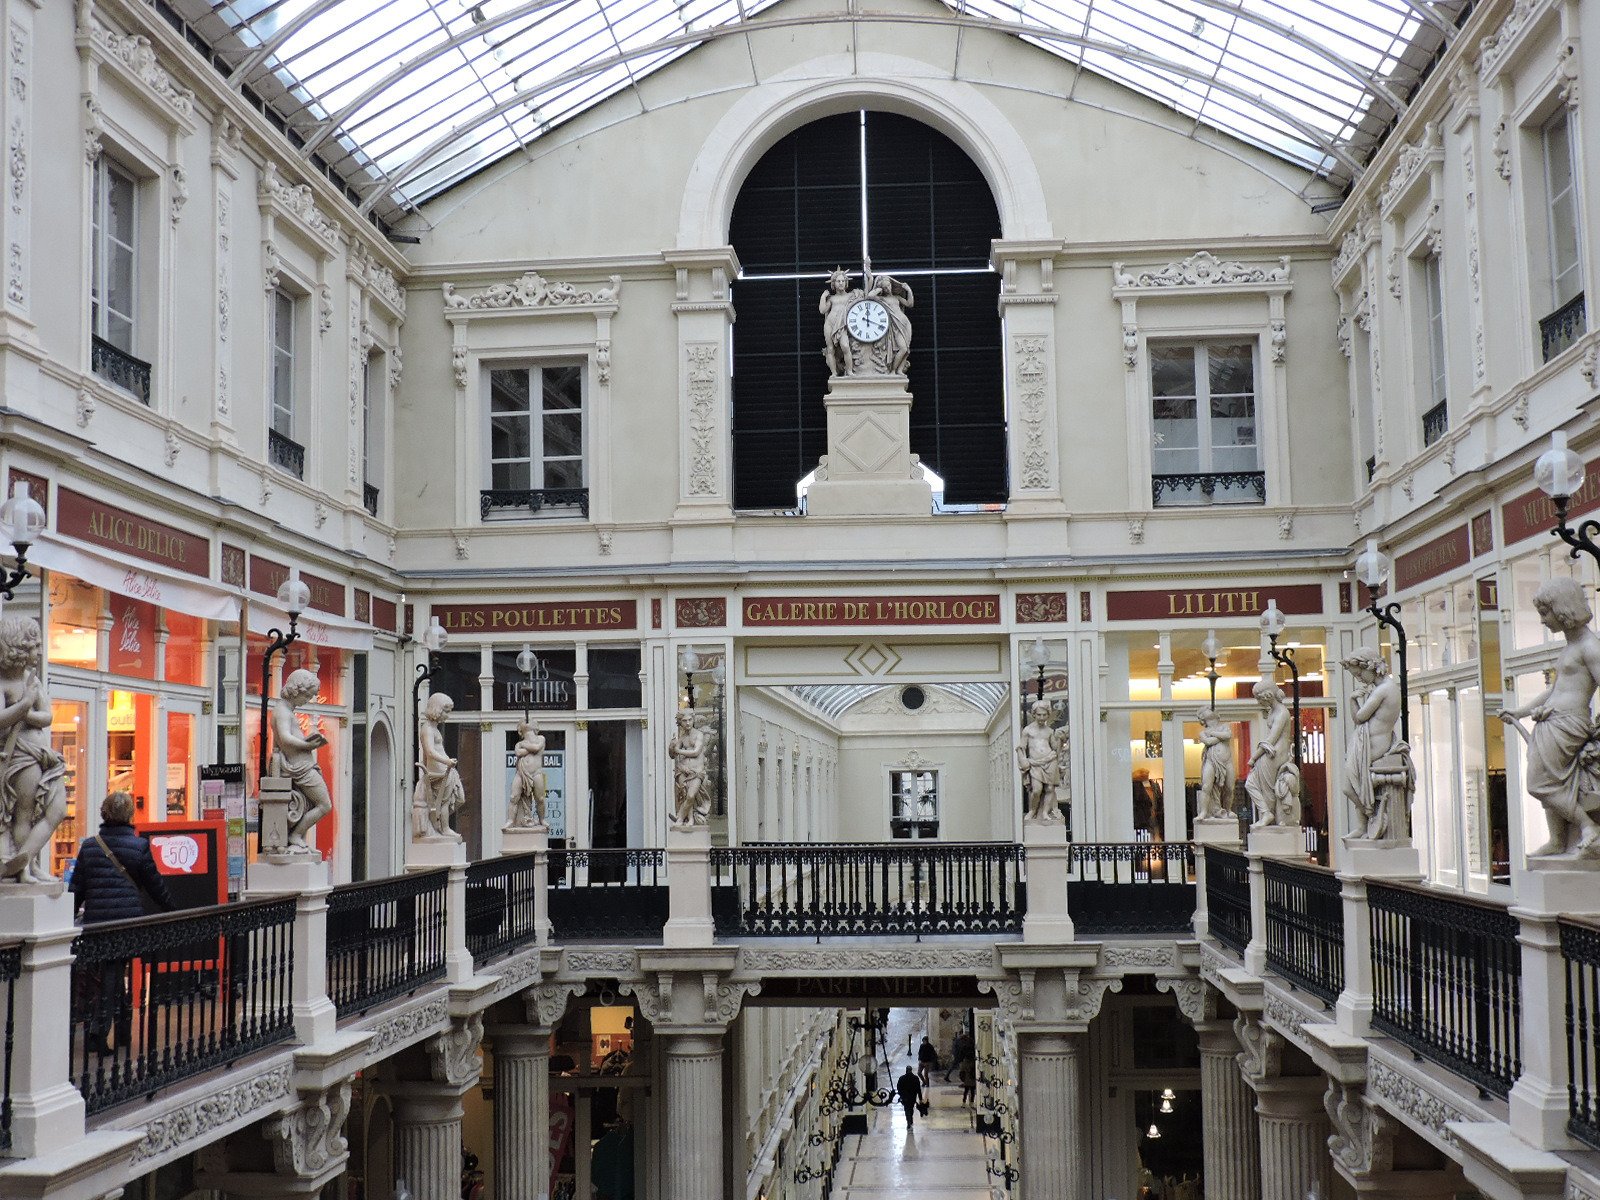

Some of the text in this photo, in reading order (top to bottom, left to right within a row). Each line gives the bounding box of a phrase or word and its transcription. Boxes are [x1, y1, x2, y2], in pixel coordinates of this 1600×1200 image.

[88, 509, 186, 563] ALICE DELICE
[747, 601, 996, 621] GALERIE DE L'HORLOGE
[1168, 591, 1261, 614] LILITH
[445, 607, 622, 628] LES POULETTES
[543, 755, 561, 766] BAIL
